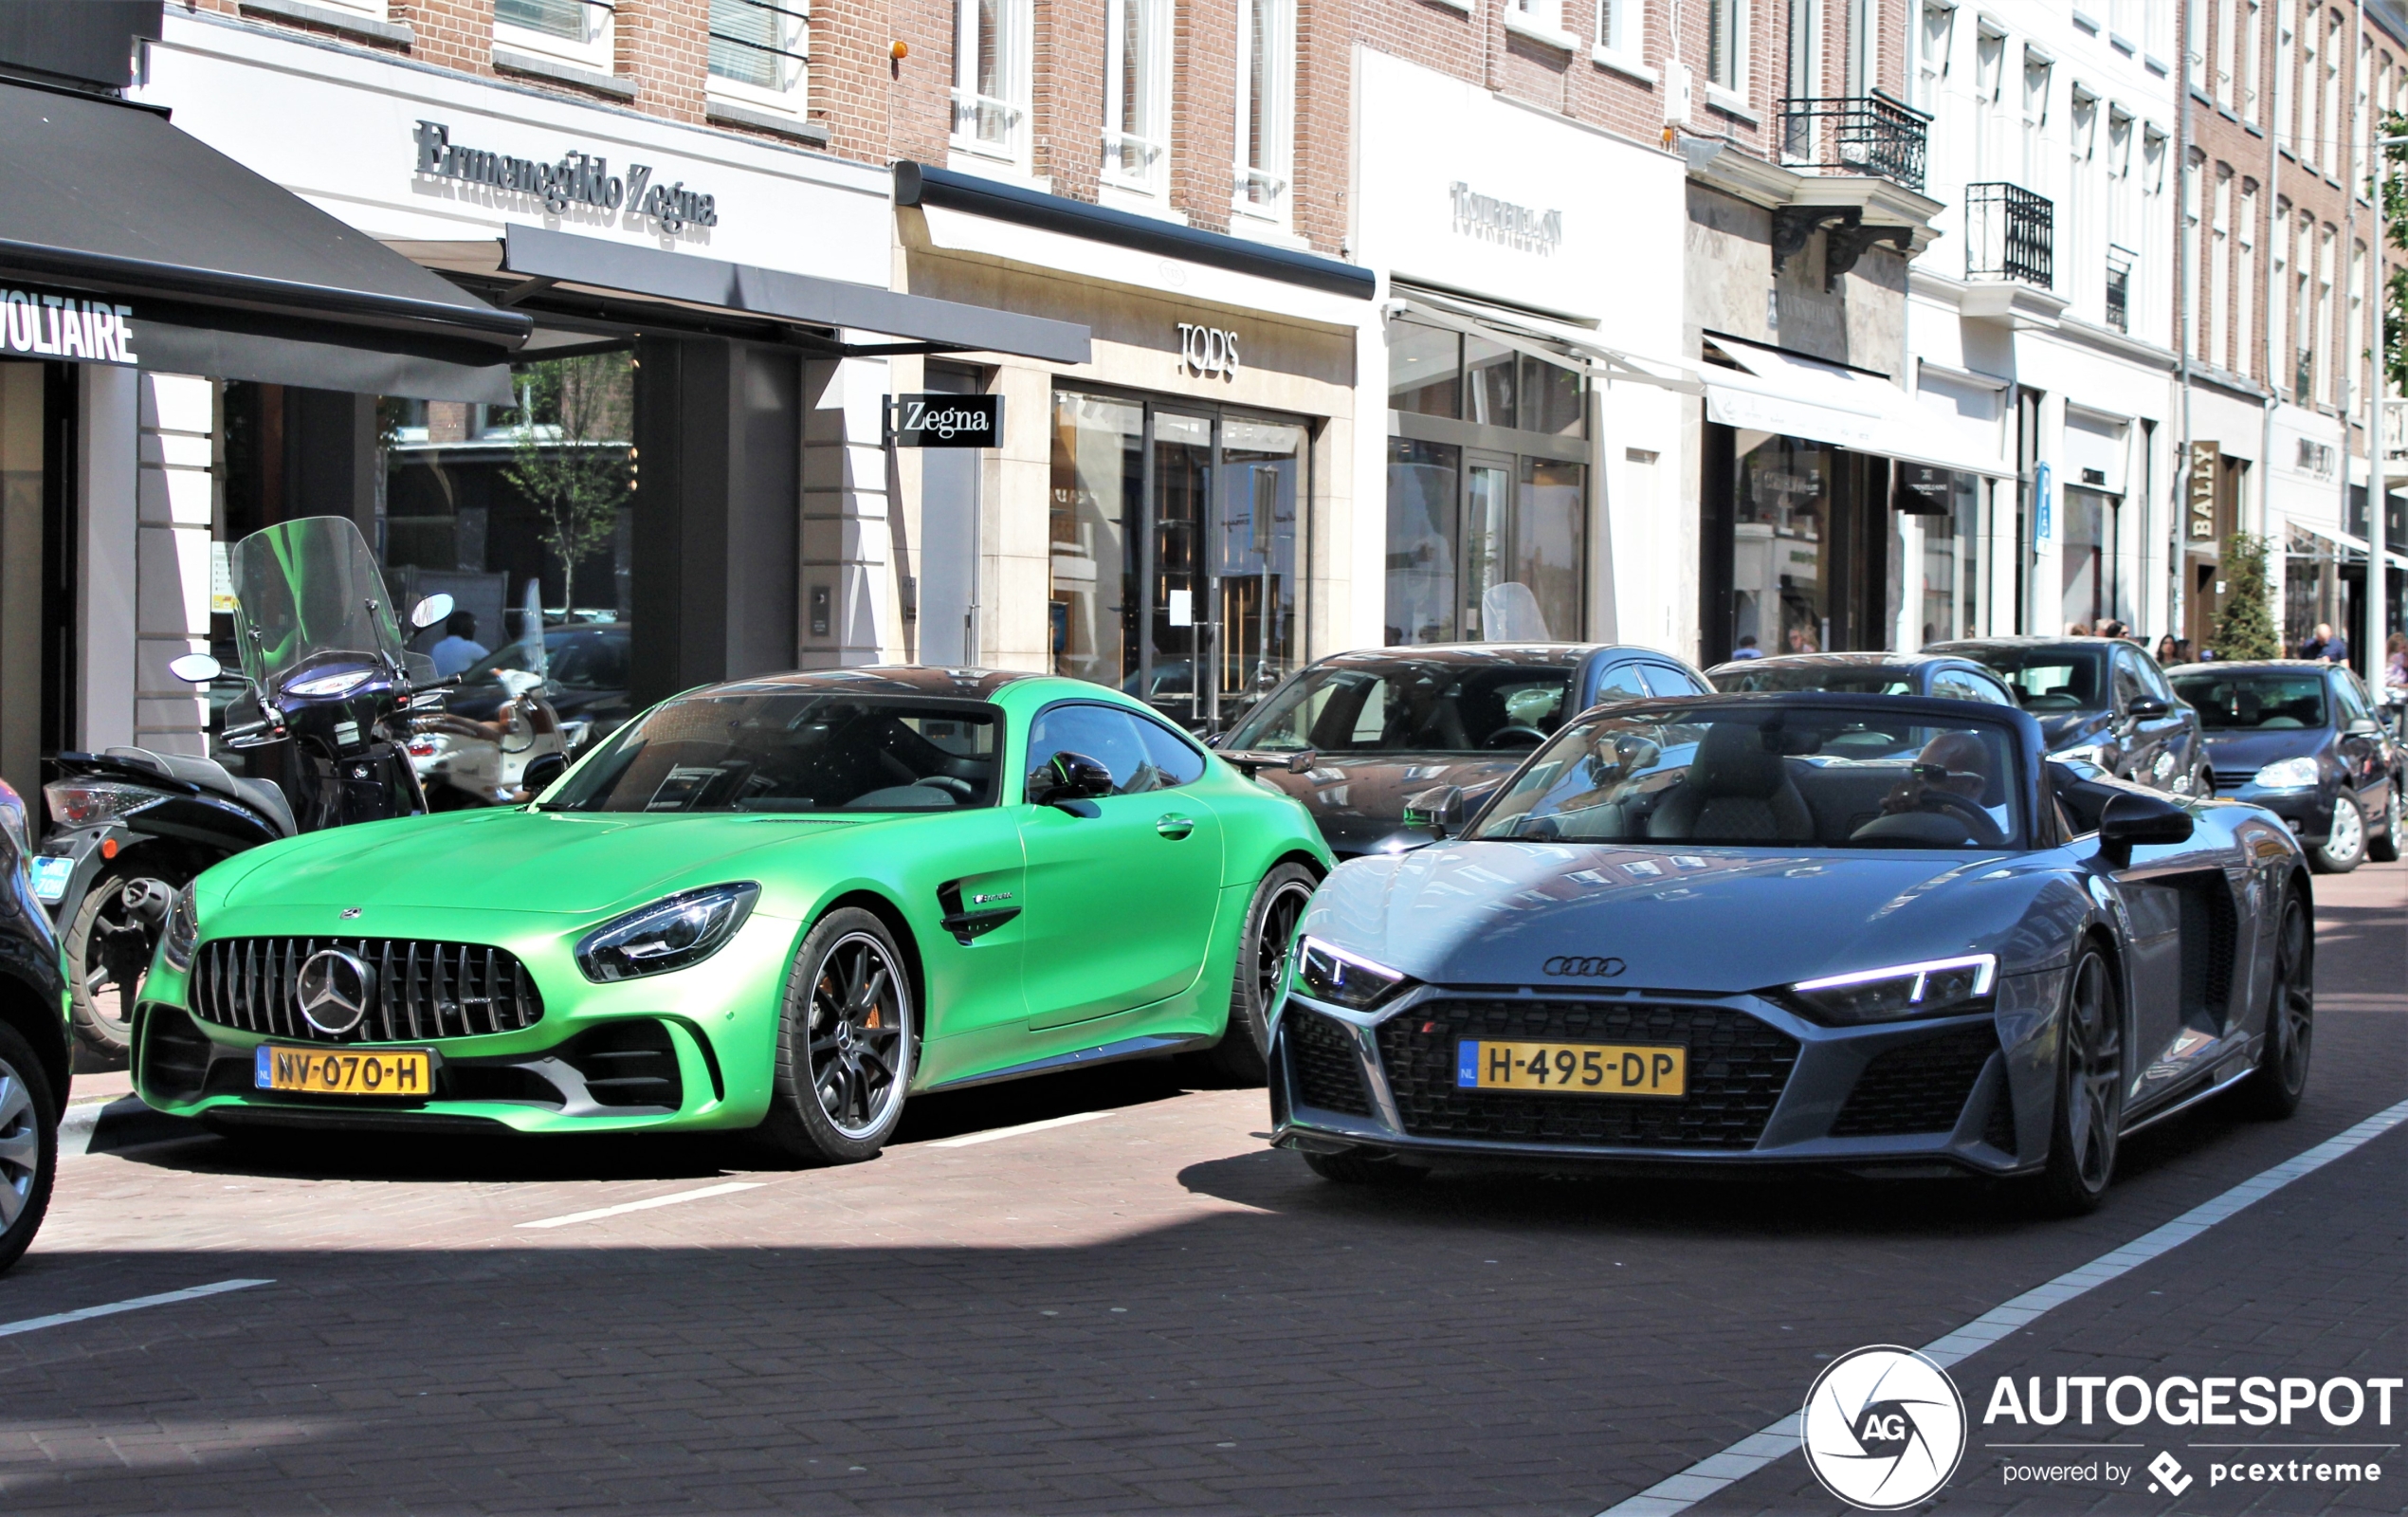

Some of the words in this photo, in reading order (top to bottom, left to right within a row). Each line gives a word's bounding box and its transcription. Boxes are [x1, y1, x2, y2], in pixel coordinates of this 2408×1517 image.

[413, 119, 624, 215] Ermenegildo
[626, 163, 718, 234] Zegna
[1177, 322, 1239, 375] TOD'S
[904, 401, 990, 439] Zegna
[2192, 445, 2215, 537] BALLY
[260, 1070, 270, 1081] NL
[278, 1051, 417, 1089] NV-070-H
[1460, 1068, 1475, 1080] NL
[1488, 1047, 1674, 1088] H-495-DP
